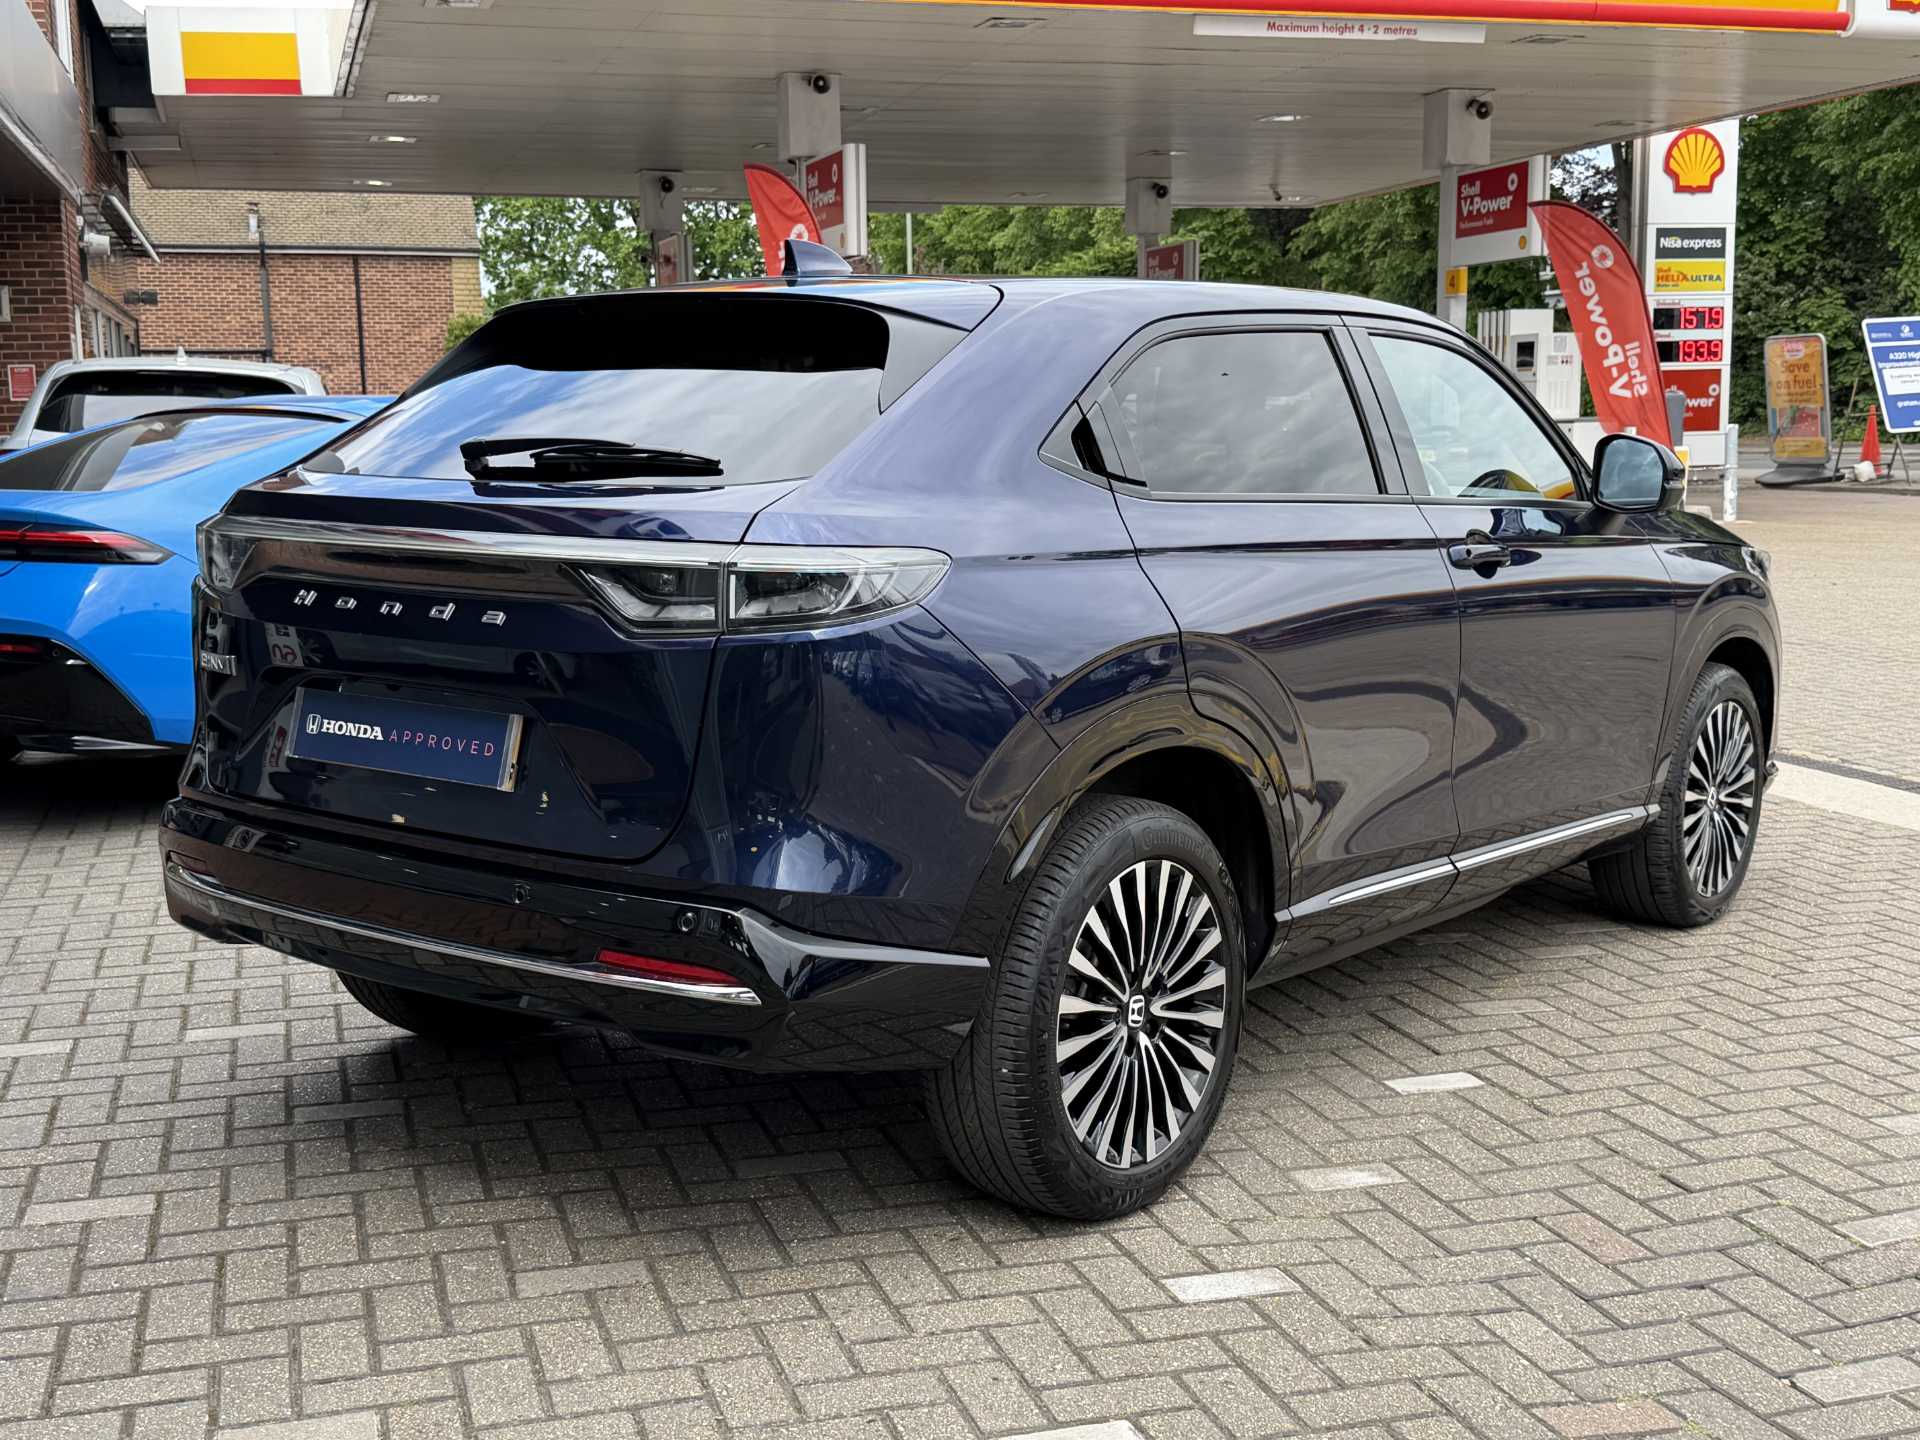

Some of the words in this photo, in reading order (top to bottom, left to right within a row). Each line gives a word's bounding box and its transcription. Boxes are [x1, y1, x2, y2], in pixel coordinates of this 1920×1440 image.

[1266, 21, 1319, 33] Maximum
[1322, 22, 1355, 35] height
[1383, 25, 1418, 35] metres
[1460, 180, 1481, 197] Shell
[1660, 237, 1681, 248] Nisa
[1682, 238, 1722, 250] express
[1690, 274, 1722, 282] ULTRA
[1680, 307, 1723, 328] 157.9
[1679, 340, 1722, 362] 193.9
[1781, 362, 1810, 373] Save
[1776, 381, 1791, 391] on
[1793, 375, 1816, 389] fuel
[293, 588, 507, 627] Honda
[321, 718, 384, 741] HONDA
[388, 728, 495, 757] APPROVED
